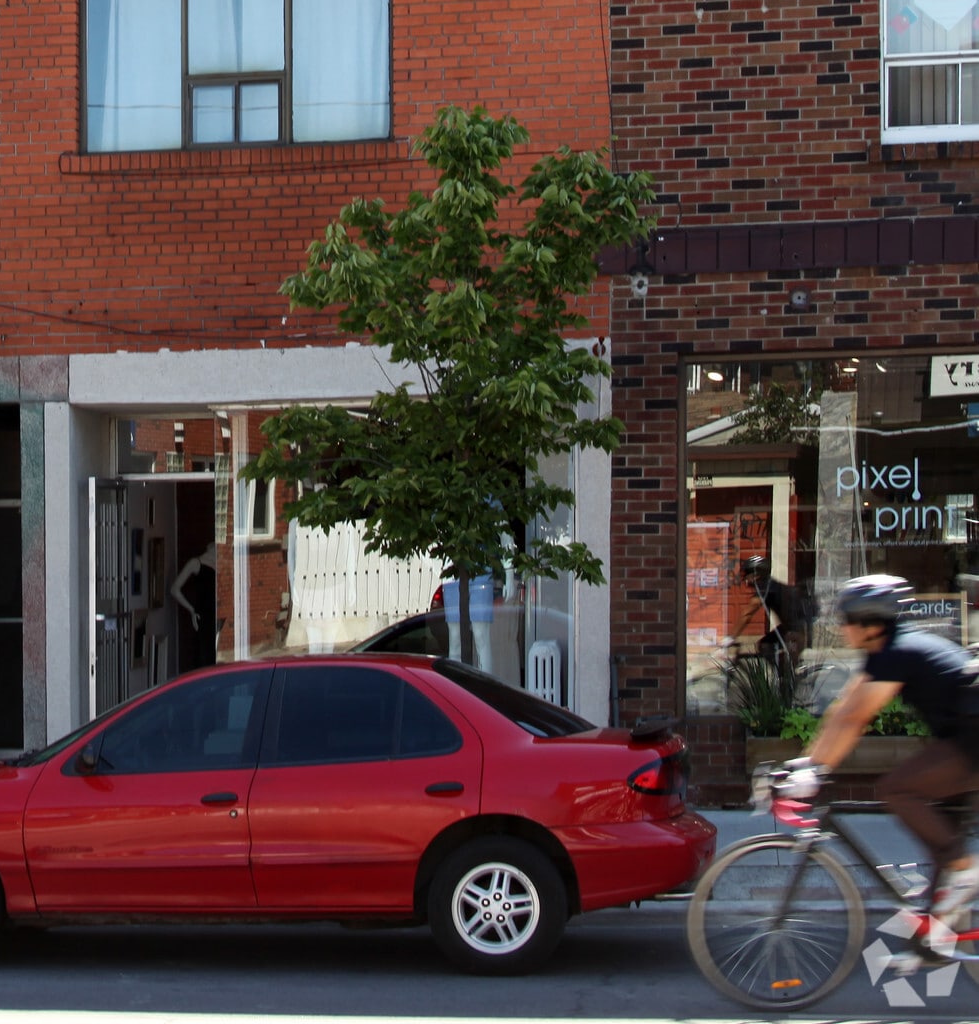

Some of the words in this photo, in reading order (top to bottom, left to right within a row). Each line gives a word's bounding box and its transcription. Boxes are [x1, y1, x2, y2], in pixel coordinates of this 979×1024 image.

[836, 457, 920, 501] pixel
[875, 504, 957, 538] print
[910, 600, 952, 619] cards
